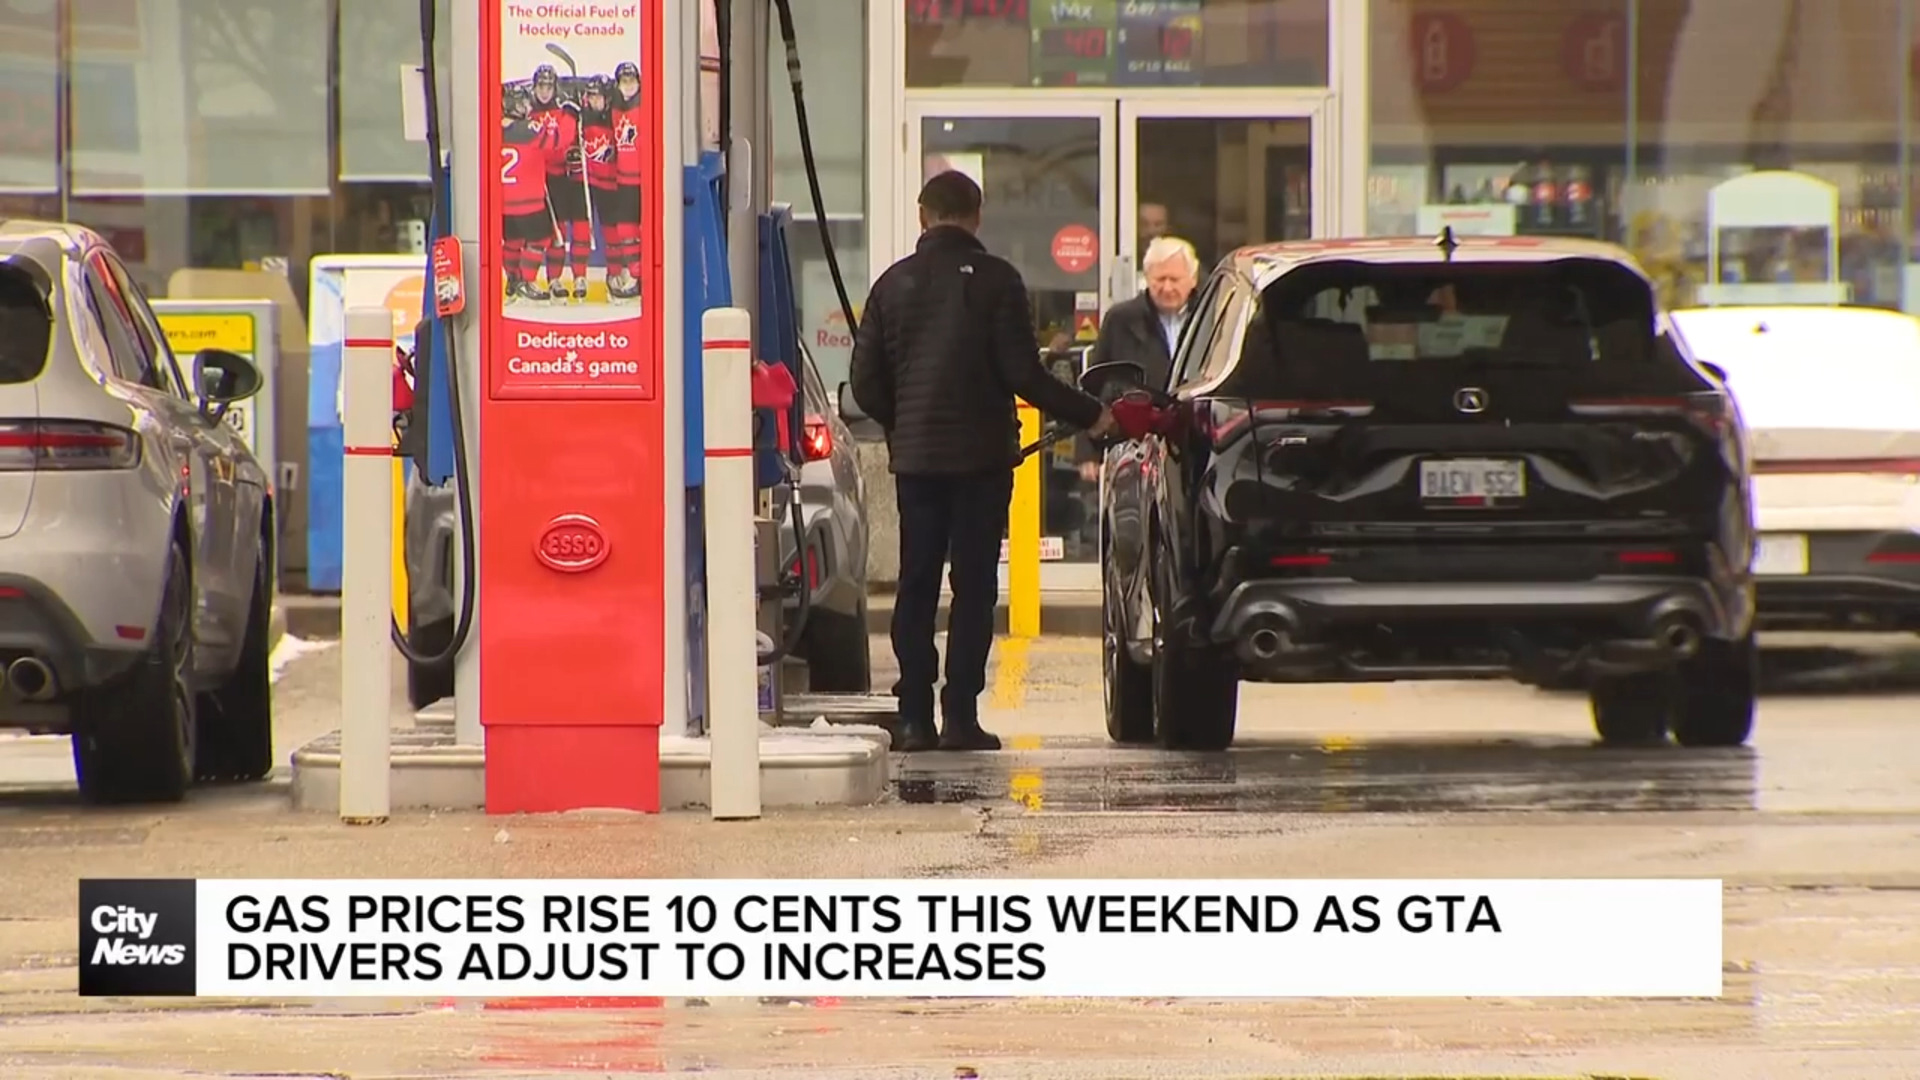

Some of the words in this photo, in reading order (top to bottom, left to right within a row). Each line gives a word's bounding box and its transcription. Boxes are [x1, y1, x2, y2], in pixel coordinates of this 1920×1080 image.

[508, 5, 533, 18] The
[536, 5, 586, 18] Official
[589, 5, 619, 18] Fuel
[621, 5, 636, 18] of
[519, 23, 571, 38] Hockey
[574, 23, 625, 36] Canada
[1063, 27, 1106, 58] 40
[517, 330, 605, 348] Dedicated
[609, 333, 629, 348] to
[508, 356, 584, 374] Canada's
[588, 359, 638, 378] game
